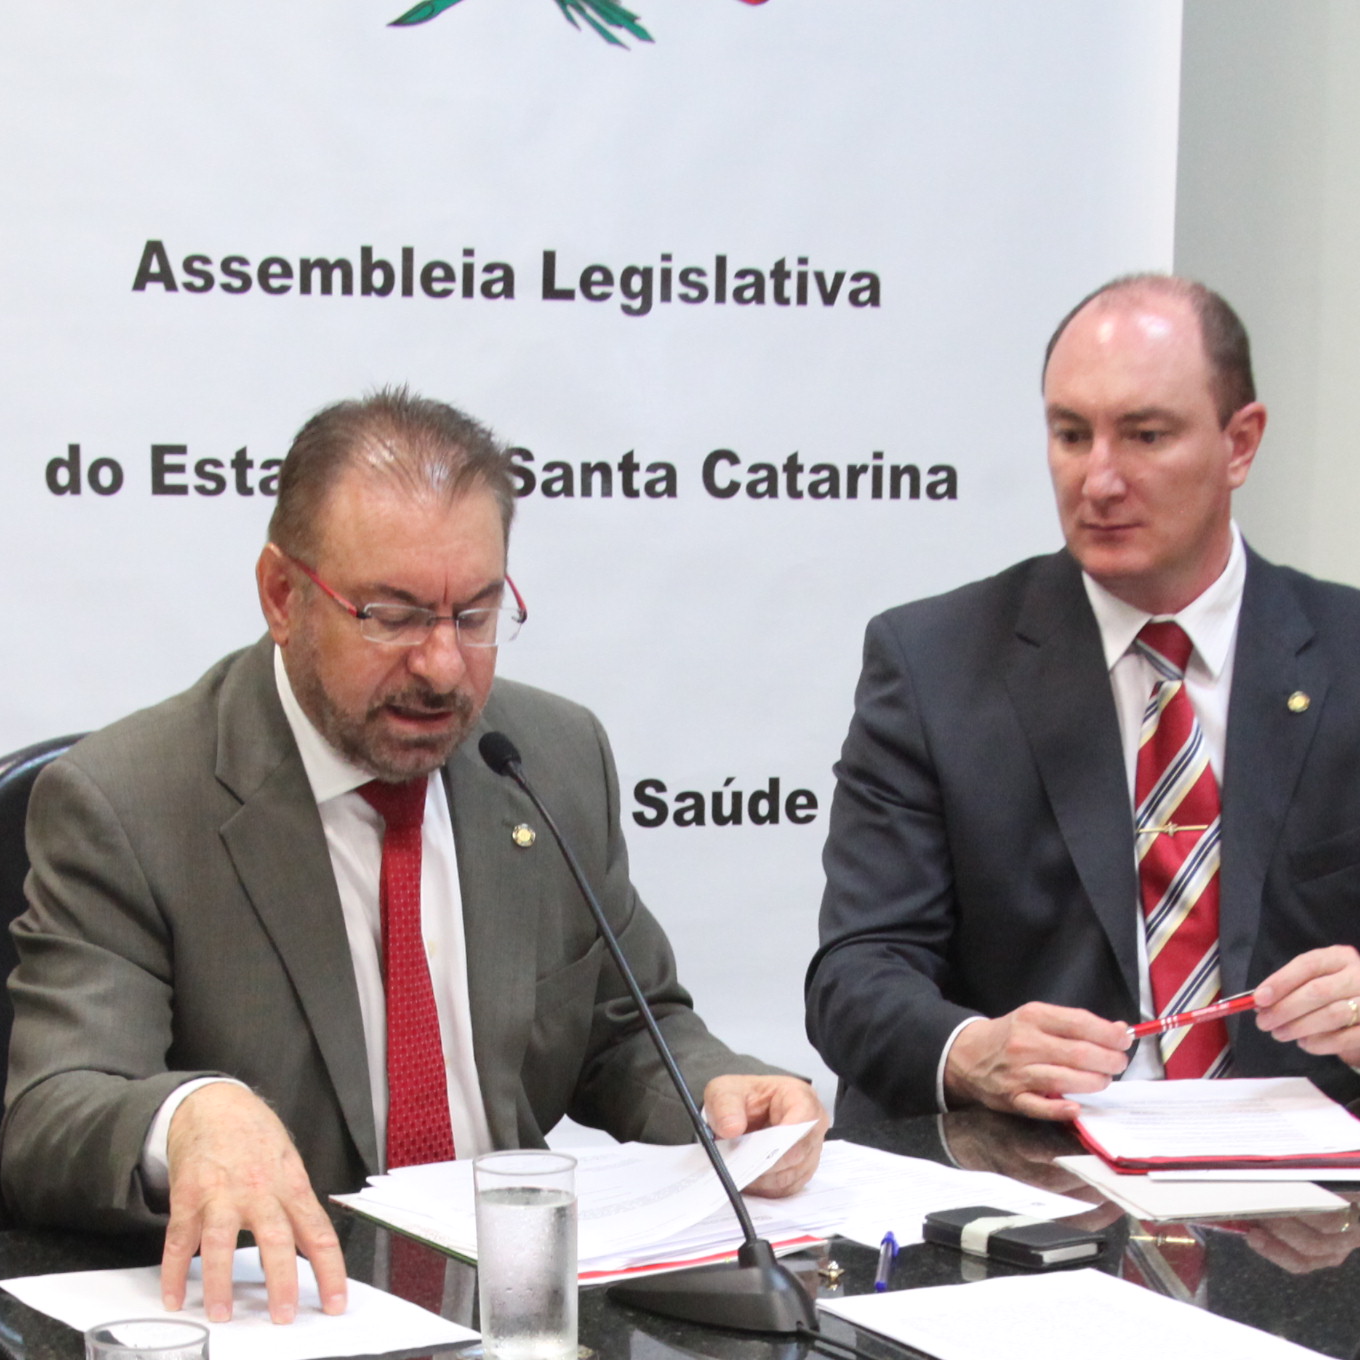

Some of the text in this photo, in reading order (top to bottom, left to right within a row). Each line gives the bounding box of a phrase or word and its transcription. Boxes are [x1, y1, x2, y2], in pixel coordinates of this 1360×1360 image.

[132, 240, 882, 317] Assembleia Legislativa
[45, 443, 960, 501] do Esta Santa Catarina
[632, 776, 819, 828] Saúde
